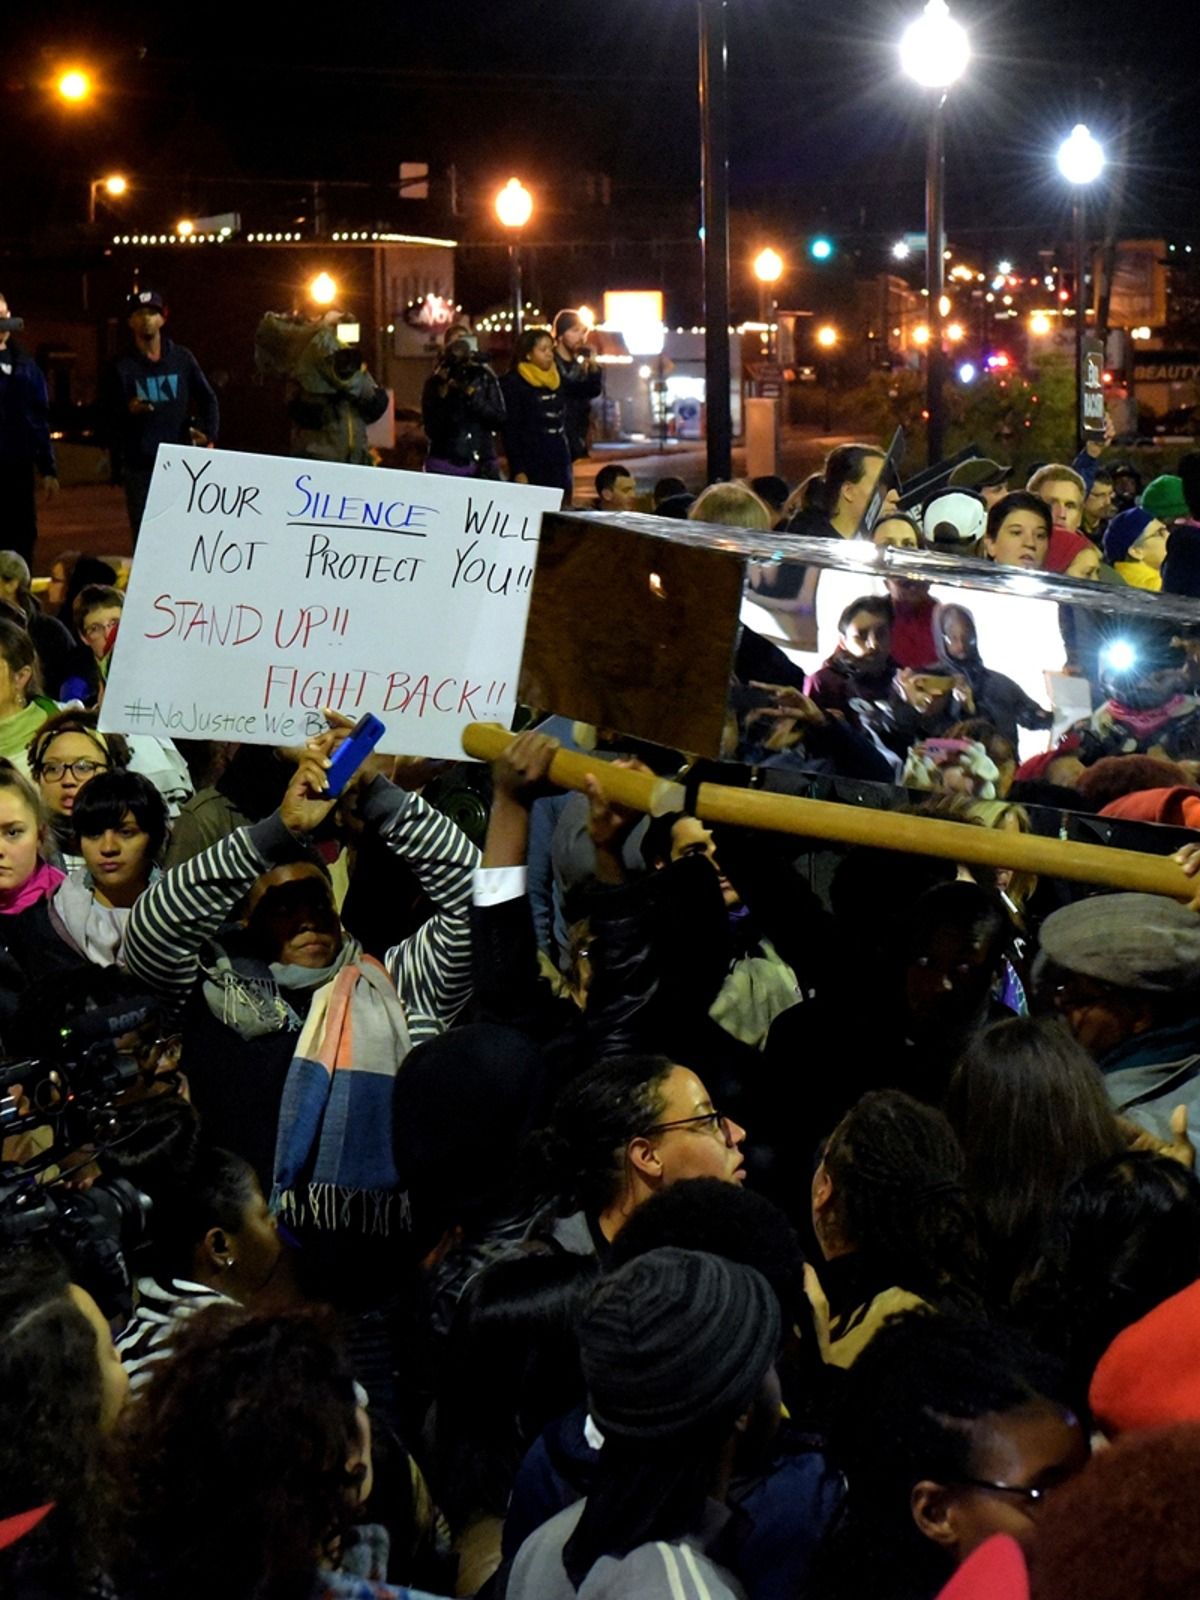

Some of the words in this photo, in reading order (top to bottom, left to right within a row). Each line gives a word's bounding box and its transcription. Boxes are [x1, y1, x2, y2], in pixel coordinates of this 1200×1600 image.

[287, 474, 439, 529] SILENCE
[465, 497, 541, 542] WILL
[190, 530, 268, 574] NOT
[304, 533, 426, 583] PROTECT
[450, 540, 533, 596] YOU!!
[144, 594, 264, 647] STAND
[274, 605, 350, 649] UP!!
[263, 665, 381, 712] FIGHT
[383, 671, 507, 720] BACK!!
